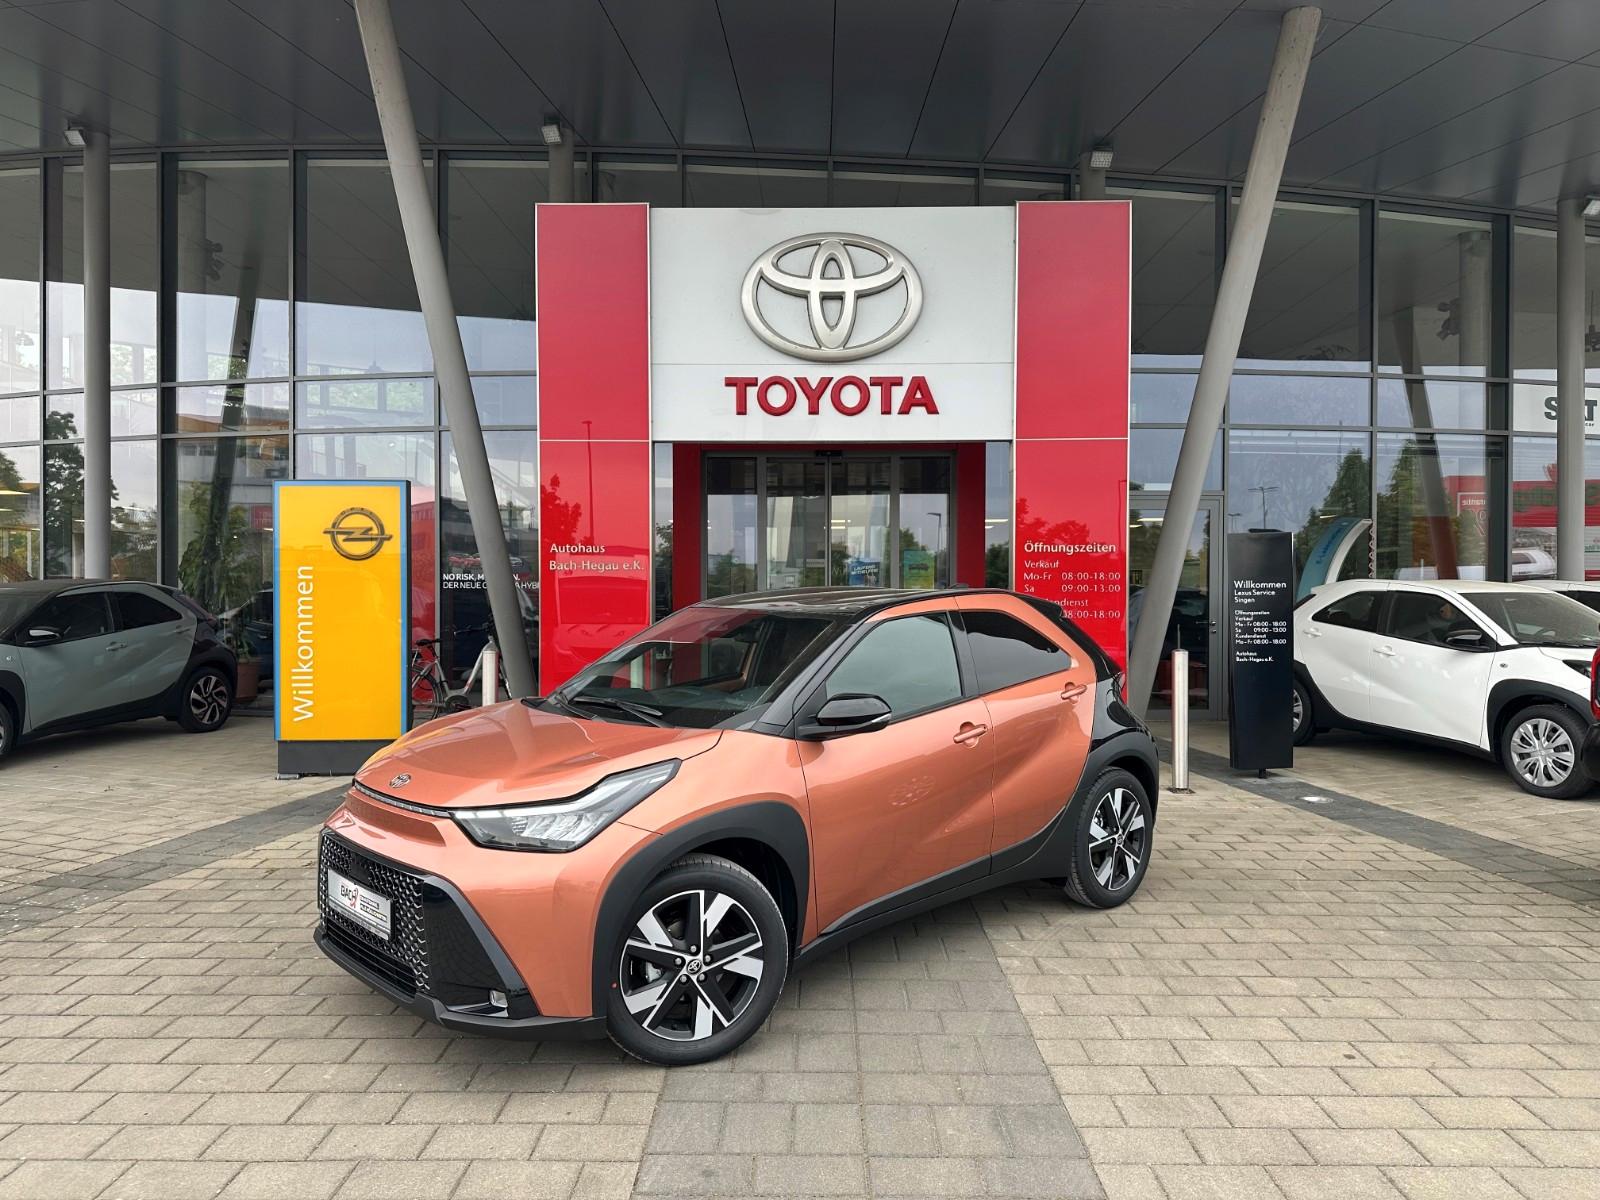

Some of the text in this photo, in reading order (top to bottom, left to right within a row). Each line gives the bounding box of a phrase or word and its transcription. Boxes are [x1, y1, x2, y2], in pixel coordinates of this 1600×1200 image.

[724, 375, 940, 417] TOYOTA
[549, 543, 606, 553] Autohaus
[1024, 540, 1116, 555] Öffnungszeiten
[549, 560, 645, 573] Bach-Hegau e.K.
[1024, 560, 1059, 568] Verkauf
[442, 573, 456, 581] NO
[1023, 572, 1121, 581] Mo-Fr 08:00-18:00
[442, 581, 460, 589] DER
[460, 581, 482, 589] NEUE
[1024, 584, 1121, 593] Sa 09:00-13:00
[1234, 580, 1287, 588] Willkommen
[291, 565, 314, 722] Willkommen
